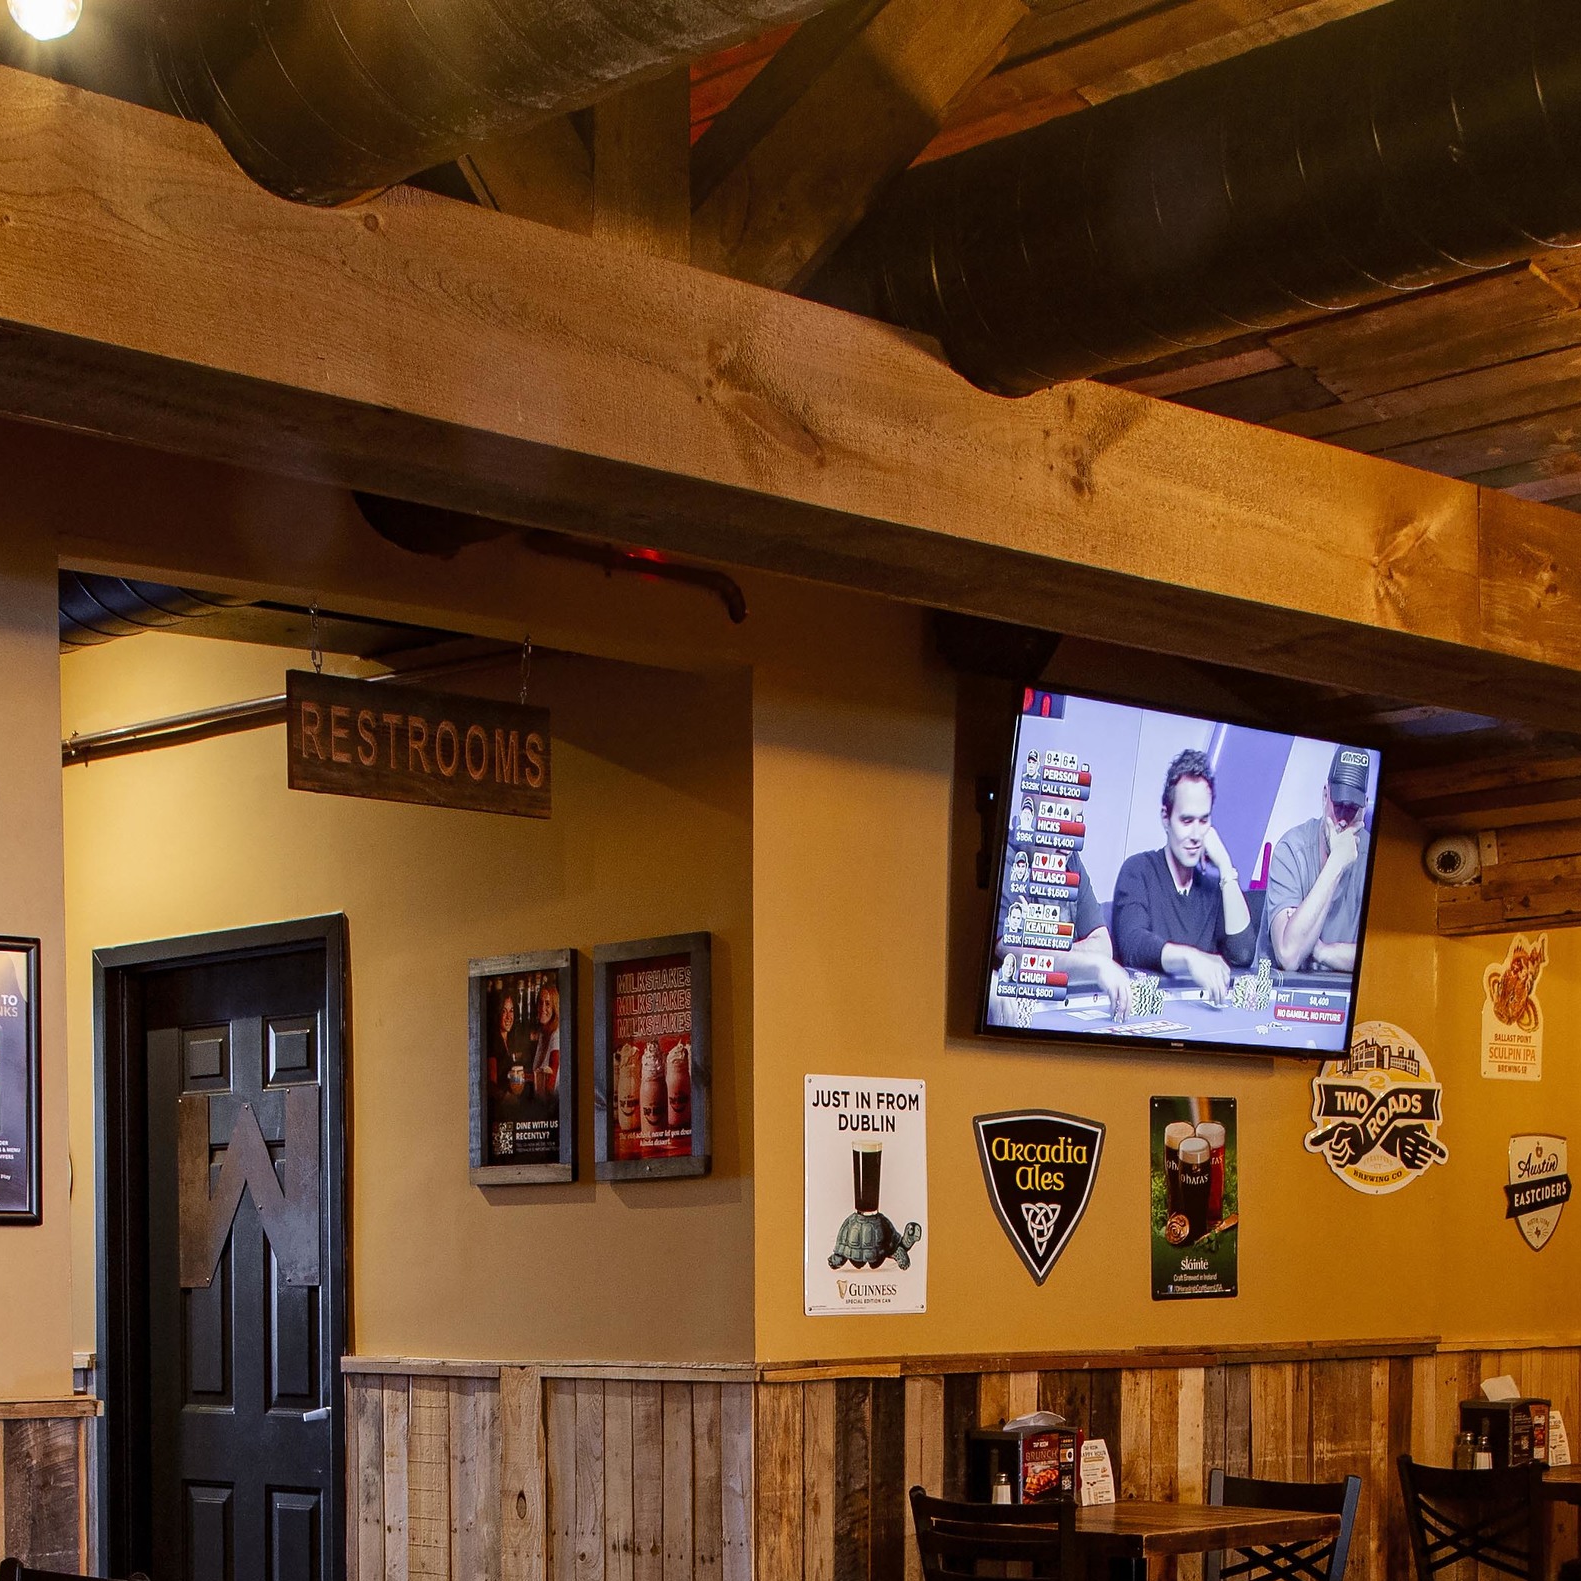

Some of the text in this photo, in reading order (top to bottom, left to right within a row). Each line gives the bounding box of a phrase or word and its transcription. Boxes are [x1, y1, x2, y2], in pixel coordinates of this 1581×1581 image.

[301, 702, 545, 788] RESTROOMS
[1043, 769, 1079, 784] PERSSON
[1042, 784, 1080, 797] CALL $1,200
[1038, 820, 1060, 832] HICKS
[1036, 835, 1075, 848] CALL $1,400
[1032, 871, 1066, 884] VELASCO
[1030, 886, 1046, 895] CALL
[1026, 922, 1058, 934] KEATING
[1024, 937, 1051, 947] STRADDLE
[617, 966, 691, 994] MILKSHAKES
[1020, 972, 1047, 984] CHUGH
[1019, 986, 1053, 998] CALL $800
[1277, 994, 1289, 1002] POT
[1, 995, 18, 1006] TO
[617, 989, 691, 1016] MILKSHAKES
[1277, 1008, 1341, 1022] NO GAMBLE, NO FUTURE
[617, 1012, 691, 1038] MILKSHAKES
[1495, 1034, 1531, 1043] BALLAST POINT
[1489, 1047, 1536, 1062] SCULPIN IPA
[1369, 1076, 1385, 1088] 2
[812, 1090, 919, 1111] JUST IN FROM
[1335, 1091, 1422, 1140] TWO ROADS
[516, 1120, 559, 1130] DINE WITH US
[839, 1113, 896, 1132] DUBLIN
[515, 1132, 549, 1140] RECENTLY?
[992, 1136, 1087, 1164] Arcadia
[1518, 1152, 1559, 1178] Austin
[1016, 1164, 1065, 1191] Ales
[1353, 1170, 1389, 1182] BREWING
[1515, 1182, 1566, 1207] EASTCIDERS
[849, 1283, 897, 1297] GUINNESS
[1026, 1449, 1058, 1461] BRUNCH
